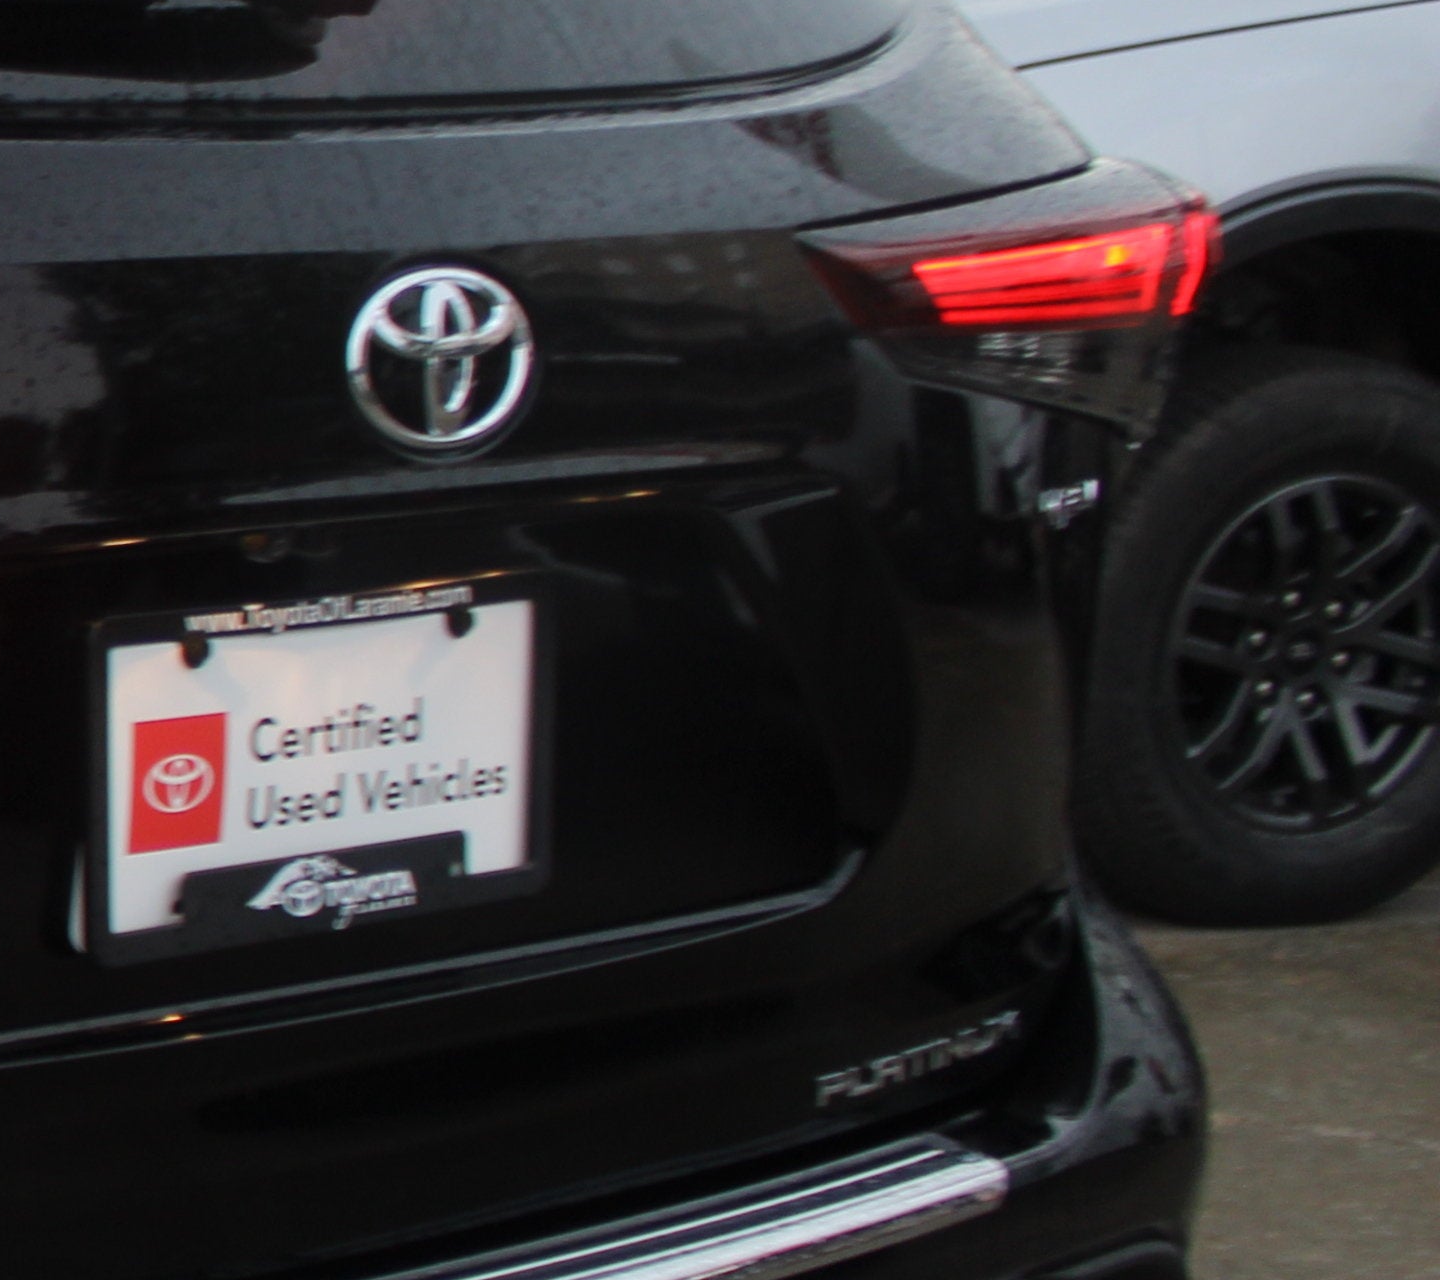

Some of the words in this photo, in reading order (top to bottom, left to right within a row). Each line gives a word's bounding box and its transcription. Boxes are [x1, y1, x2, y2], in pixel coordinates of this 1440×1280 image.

[250, 696, 425, 764] Certified
[245, 769, 344, 829] Used
[357, 758, 508, 814] Vehicles
